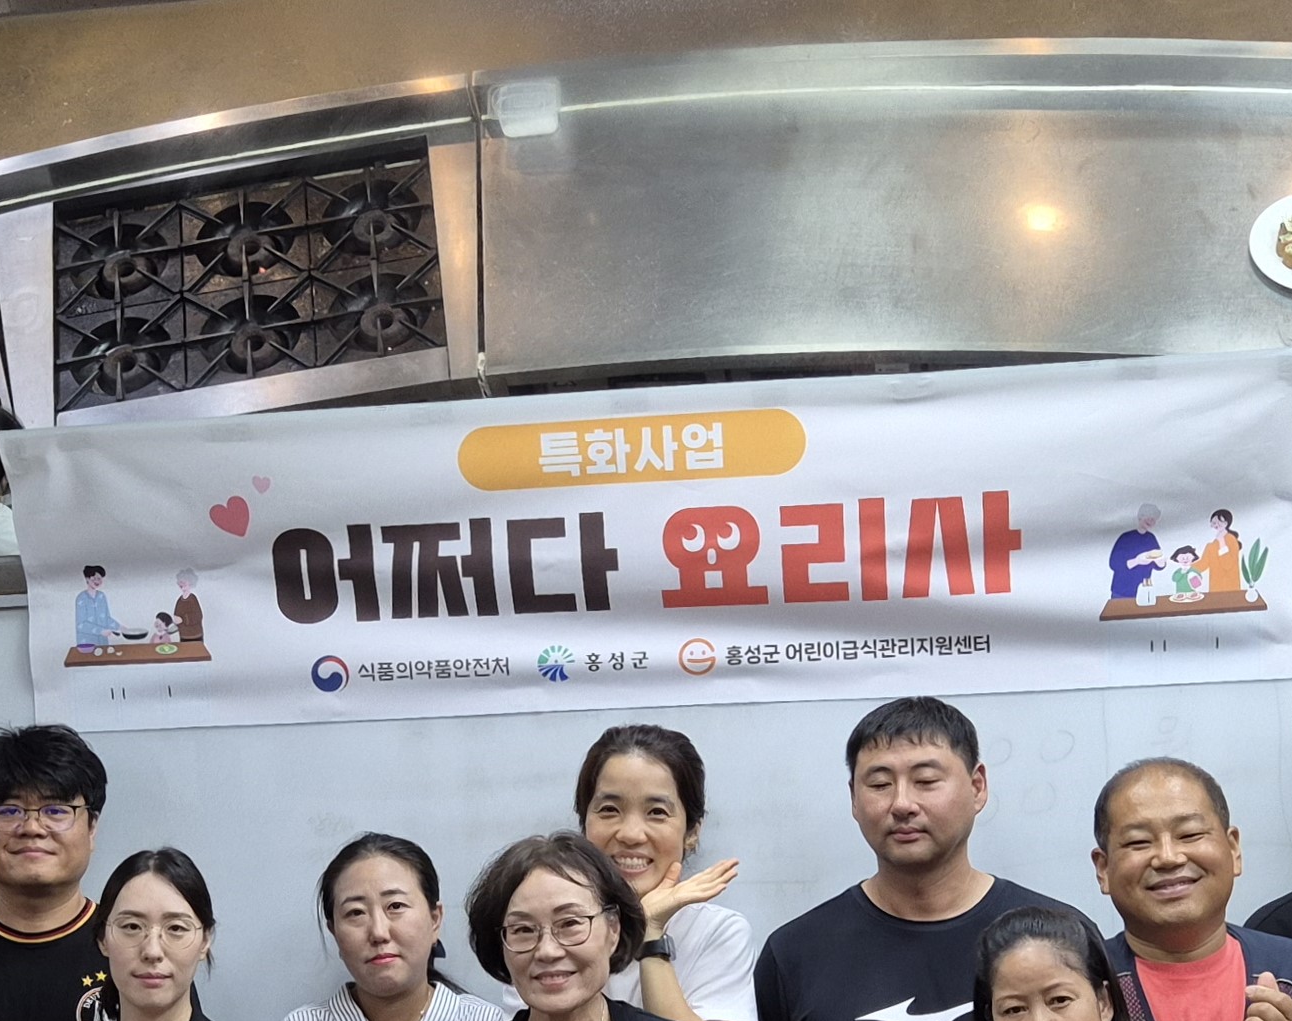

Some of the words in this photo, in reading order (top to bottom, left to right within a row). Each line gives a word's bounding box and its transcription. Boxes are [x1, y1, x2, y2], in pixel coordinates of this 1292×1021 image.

[539, 424, 724, 477] 특화사업
[272, 512, 618, 624] 어쩌다
[662, 490, 1022, 608] 요리사
[584, 651, 649, 672] 홍성군
[725, 643, 781, 666] 홍성군
[785, 634, 991, 662] 어린이급식관리지원센터
[357, 657, 510, 681] 식품의약품안전처
